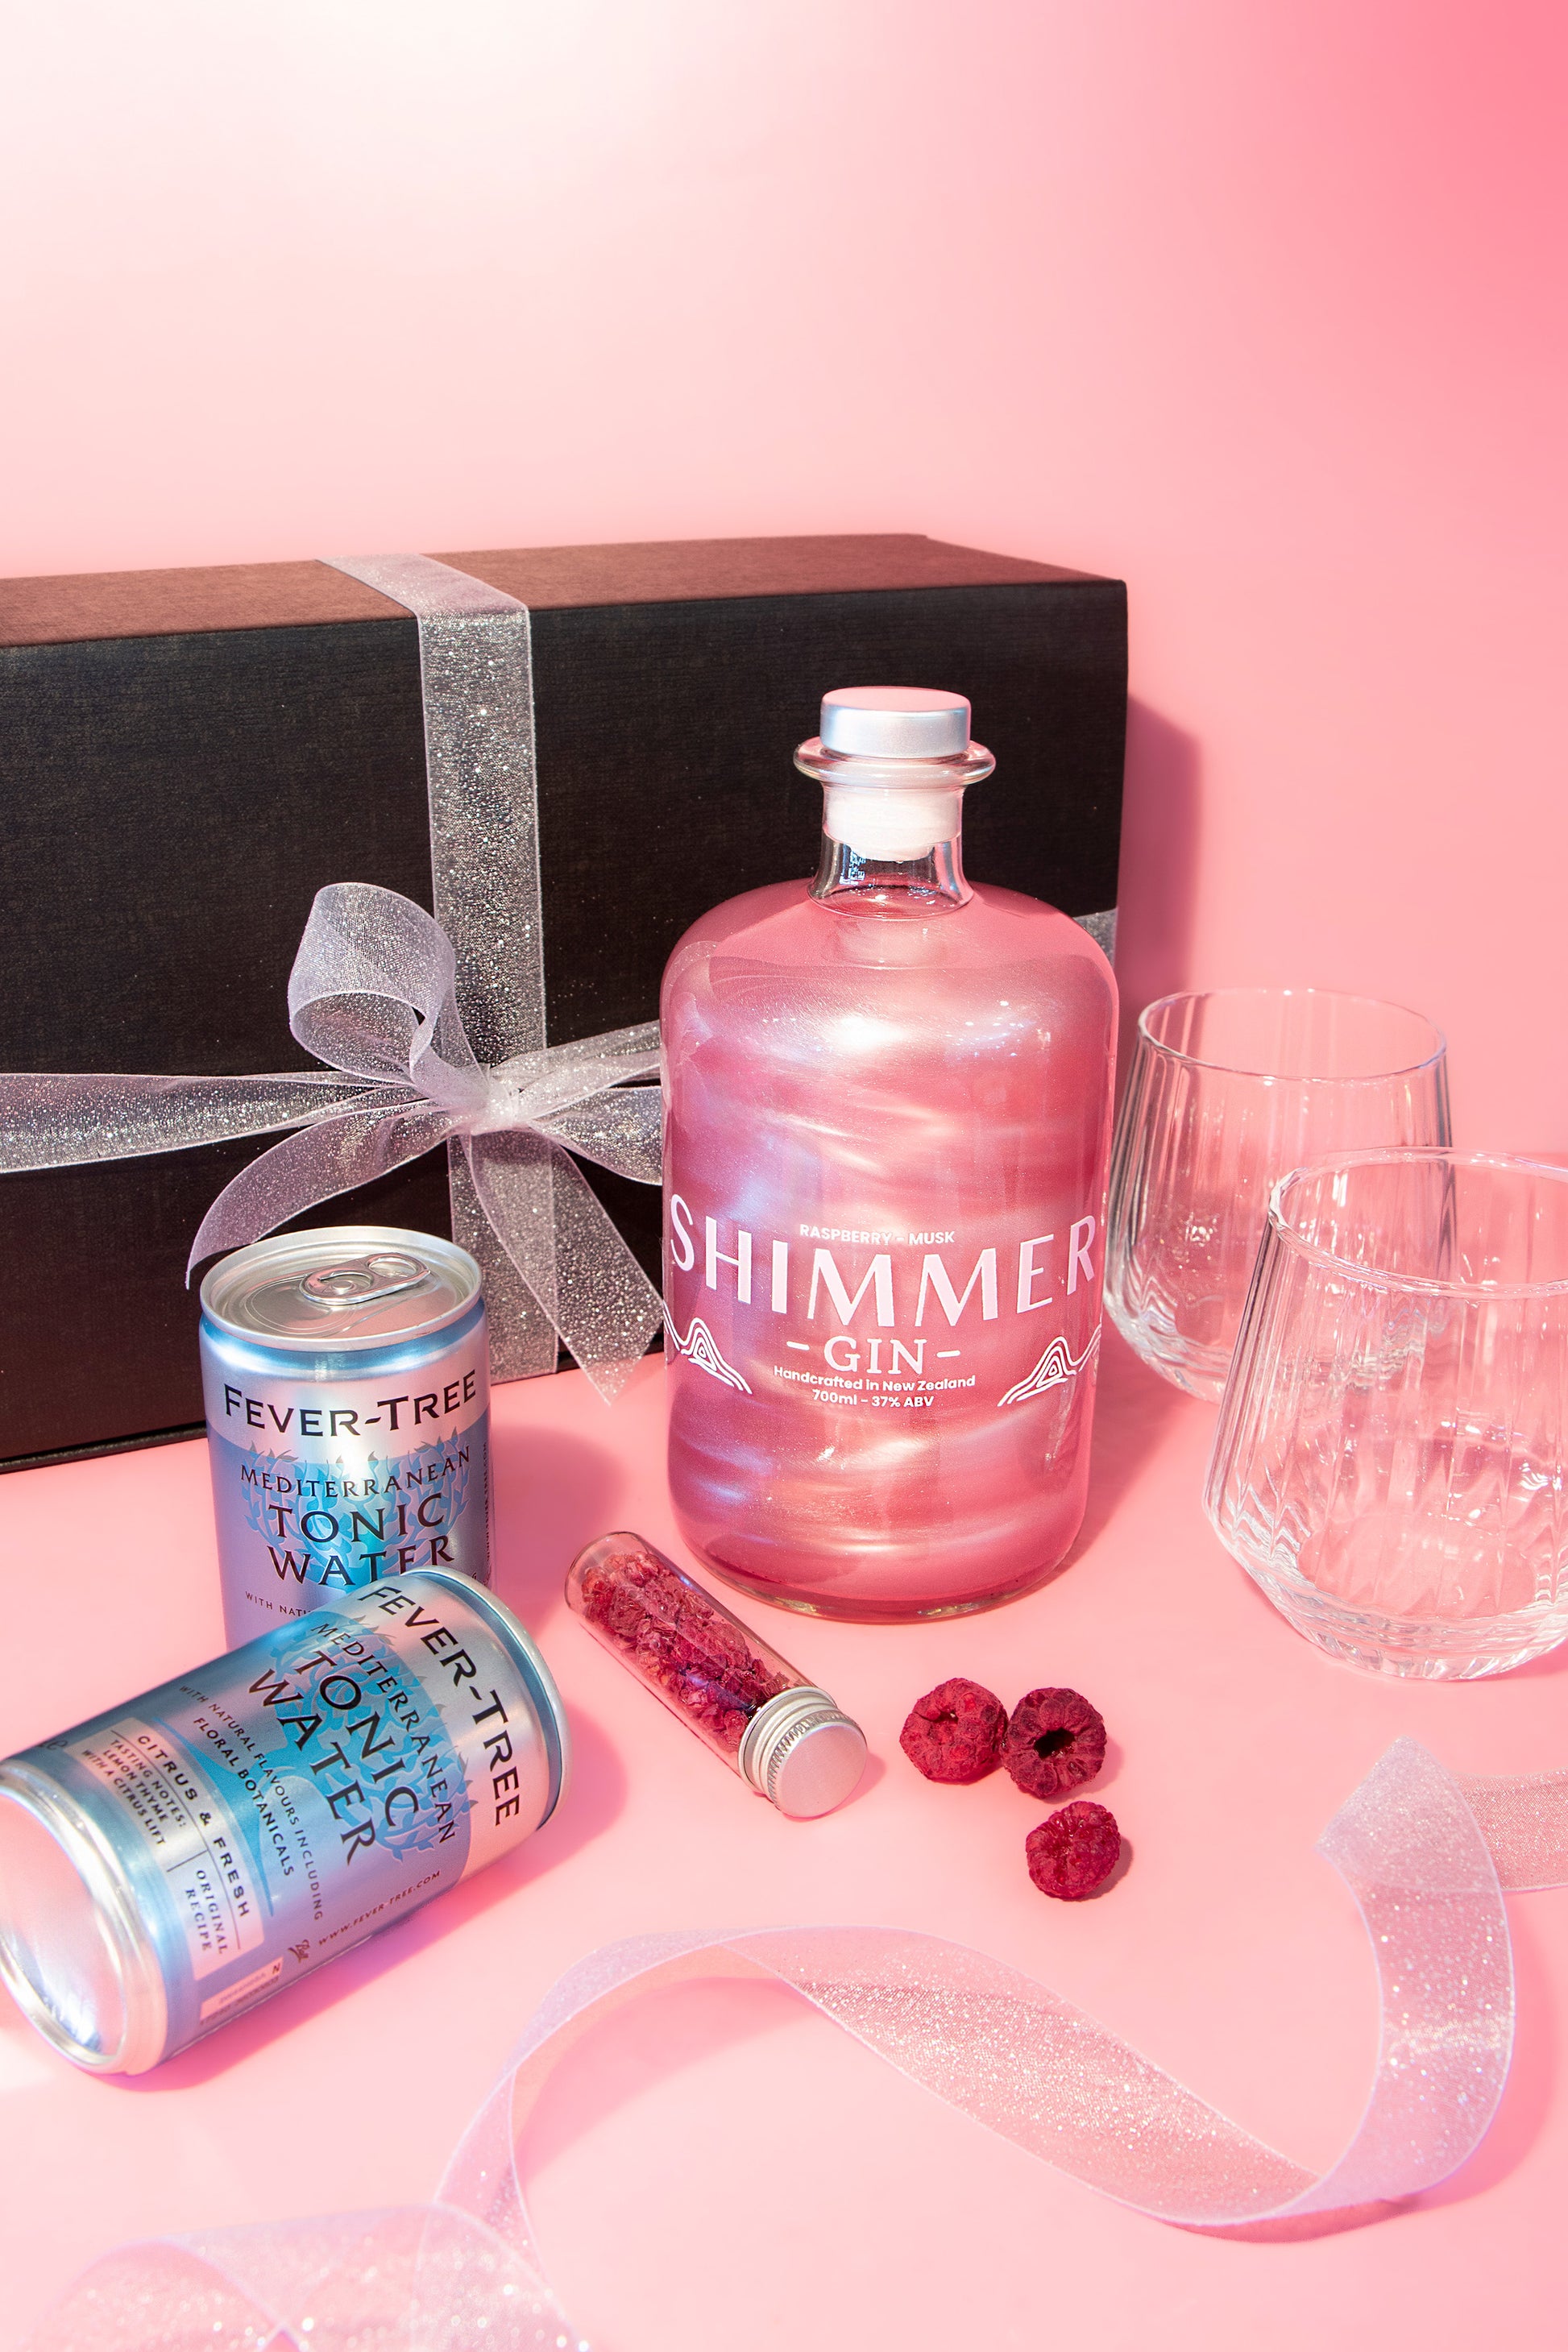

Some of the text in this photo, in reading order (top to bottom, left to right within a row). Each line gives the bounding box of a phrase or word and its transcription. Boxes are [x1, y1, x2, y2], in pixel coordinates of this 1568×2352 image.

[670, 1193, 1097, 1328] SHIMMER
[799, 1224, 892, 1246] RASPBERRY
[908, 1231, 956, 1246] MUSK
[774, 1365, 977, 1392] Handcrafted in New Zealand
[823, 1335, 927, 1375] GIN
[223, 1369, 478, 1438] FEVER-TREE
[811, 1388, 858, 1406] 700ml
[871, 1396, 901, 1408] 37%
[903, 1395, 935, 1408] ABV
[240, 1446, 471, 1498] MEDITERRANEAN
[268, 1492, 444, 1544] TONIC
[267, 1535, 455, 1587] WATER
[245, 1591, 273, 1611] WITH
[295, 1649, 420, 1827] TONIC
[310, 1622, 456, 1844] MEDITERRANEAN
[358, 1585, 521, 1827] FEVER-TREE
[82, 1748, 166, 1845] WITH A CITRUS LIFT
[102, 1748, 168, 1823] LEMON THYME
[110, 1739, 187, 1828] TASTING NOTES:
[179, 1685, 209, 1703] WITH
[208, 1703, 255, 1753] NATURAL
[254, 1753, 300, 1826] FLAVOURS
[294, 1829, 323, 1922] INCLUDING
[193, 1717, 294, 1877] FLORAL BOTANICALS
[248, 1668, 376, 1865] WATER
[137, 1735, 250, 1917] CITRUS & FRESH
[185, 1888, 212, 1952] RECIPE
[196, 1869, 228, 1954] ORIGINAL
[318, 1869, 441, 1947] WWW.FEVERTREE.COM
